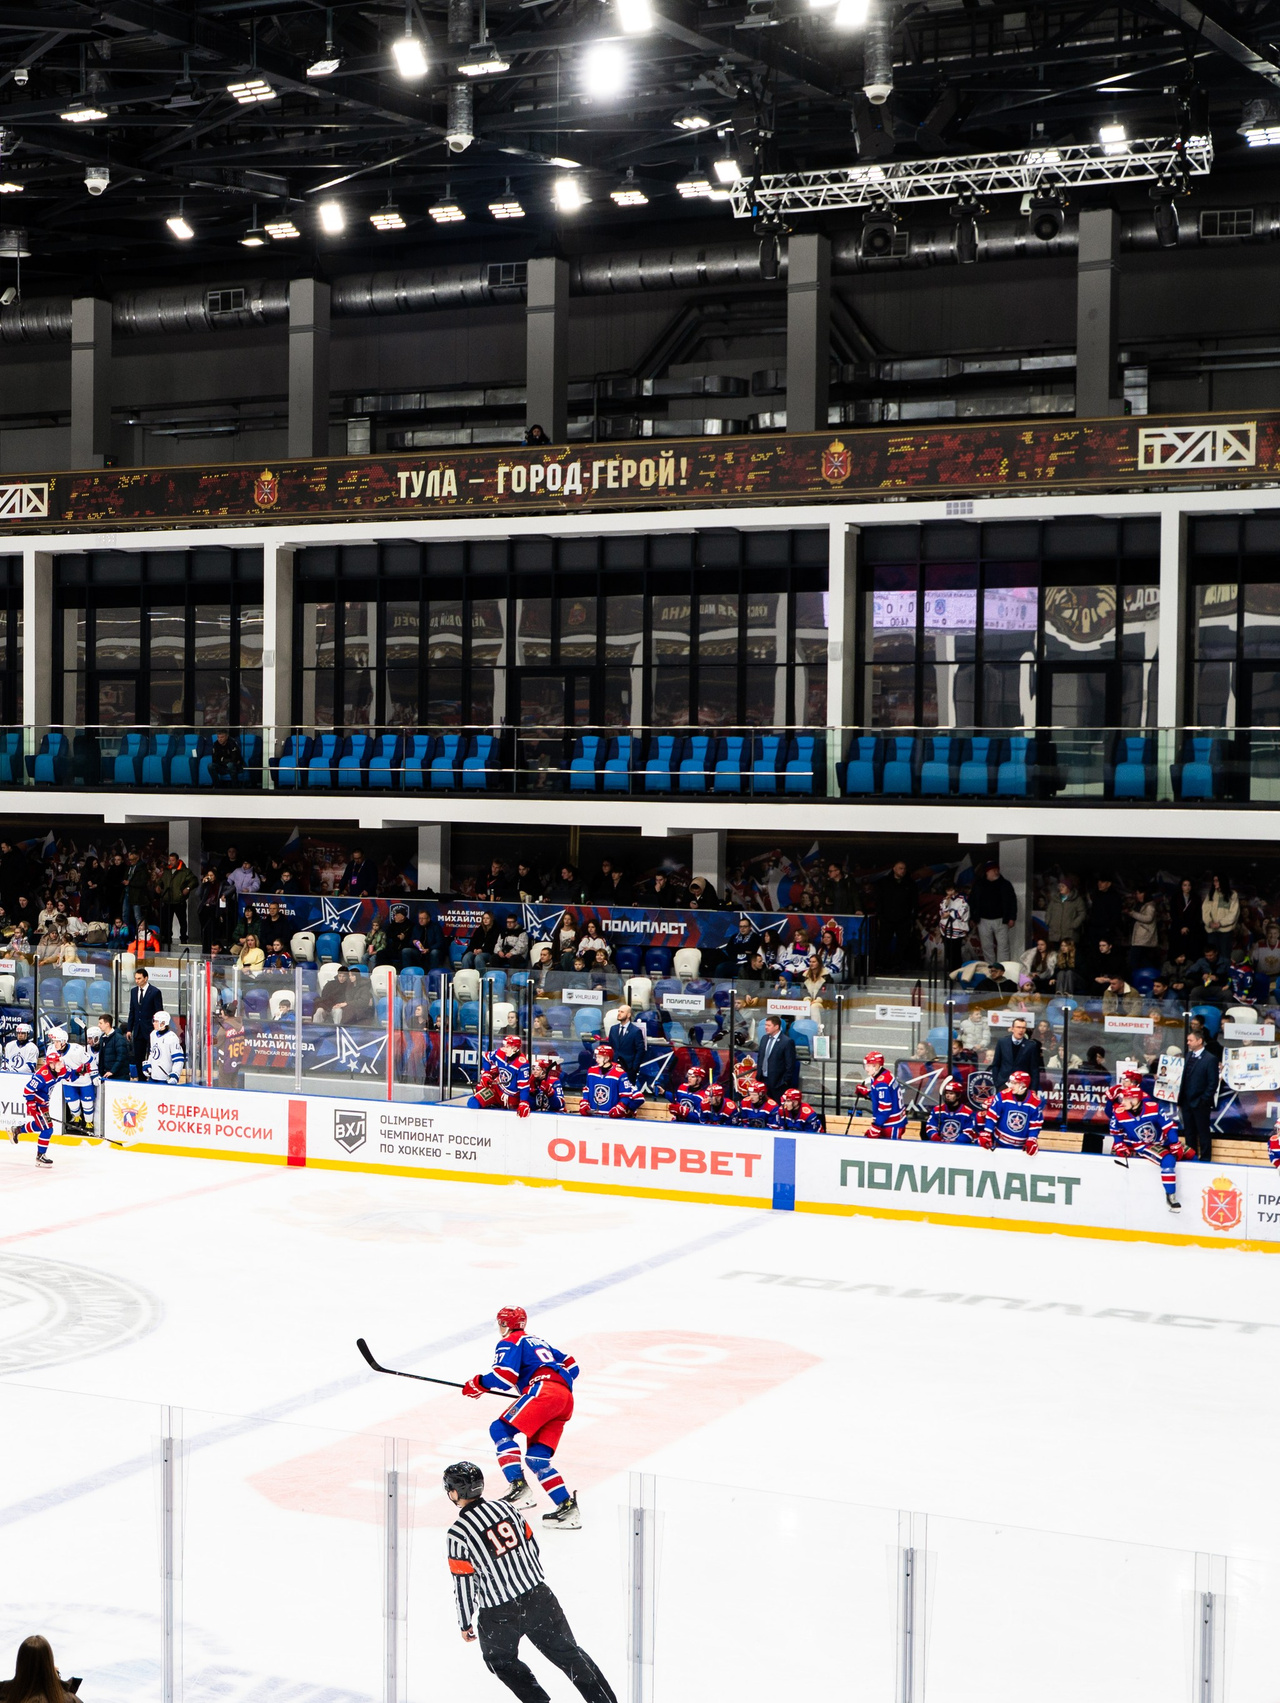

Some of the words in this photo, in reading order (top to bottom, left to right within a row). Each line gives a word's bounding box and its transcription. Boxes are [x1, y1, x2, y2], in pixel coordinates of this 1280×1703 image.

[397, 469, 458, 499] ТУЛА
[497, 450, 688, 495] ГОРОД-ГЕРОЙ!
[602, 919, 687, 936] ПОЛИПЛАСТ
[770, 1004, 808, 1012] OLIMPBET
[157, 1103, 240, 1122] ФЕДЕРАЦИЯ
[380, 1114, 435, 1128] OLIMPBET
[157, 1120, 212, 1135] ХОККЕЯ
[215, 1122, 273, 1141] РОССИИ
[336, 1121, 366, 1138] ВХЛ
[380, 1128, 446, 1144] ЧЕМПИОНАТ
[448, 1134, 492, 1148] РОССИИ
[380, 1144, 396, 1155] ПО
[398, 1145, 443, 1159] ХОККЕЮ
[455, 1150, 478, 1162] ВХЛ
[547, 1138, 762, 1179] OLIMPBET
[840, 1158, 1081, 1206] ПОЛИПЛАСТ
[718, 1269, 1280, 1335] ПОЛИПЛАСТ
[486, 1520, 520, 1558] 19
